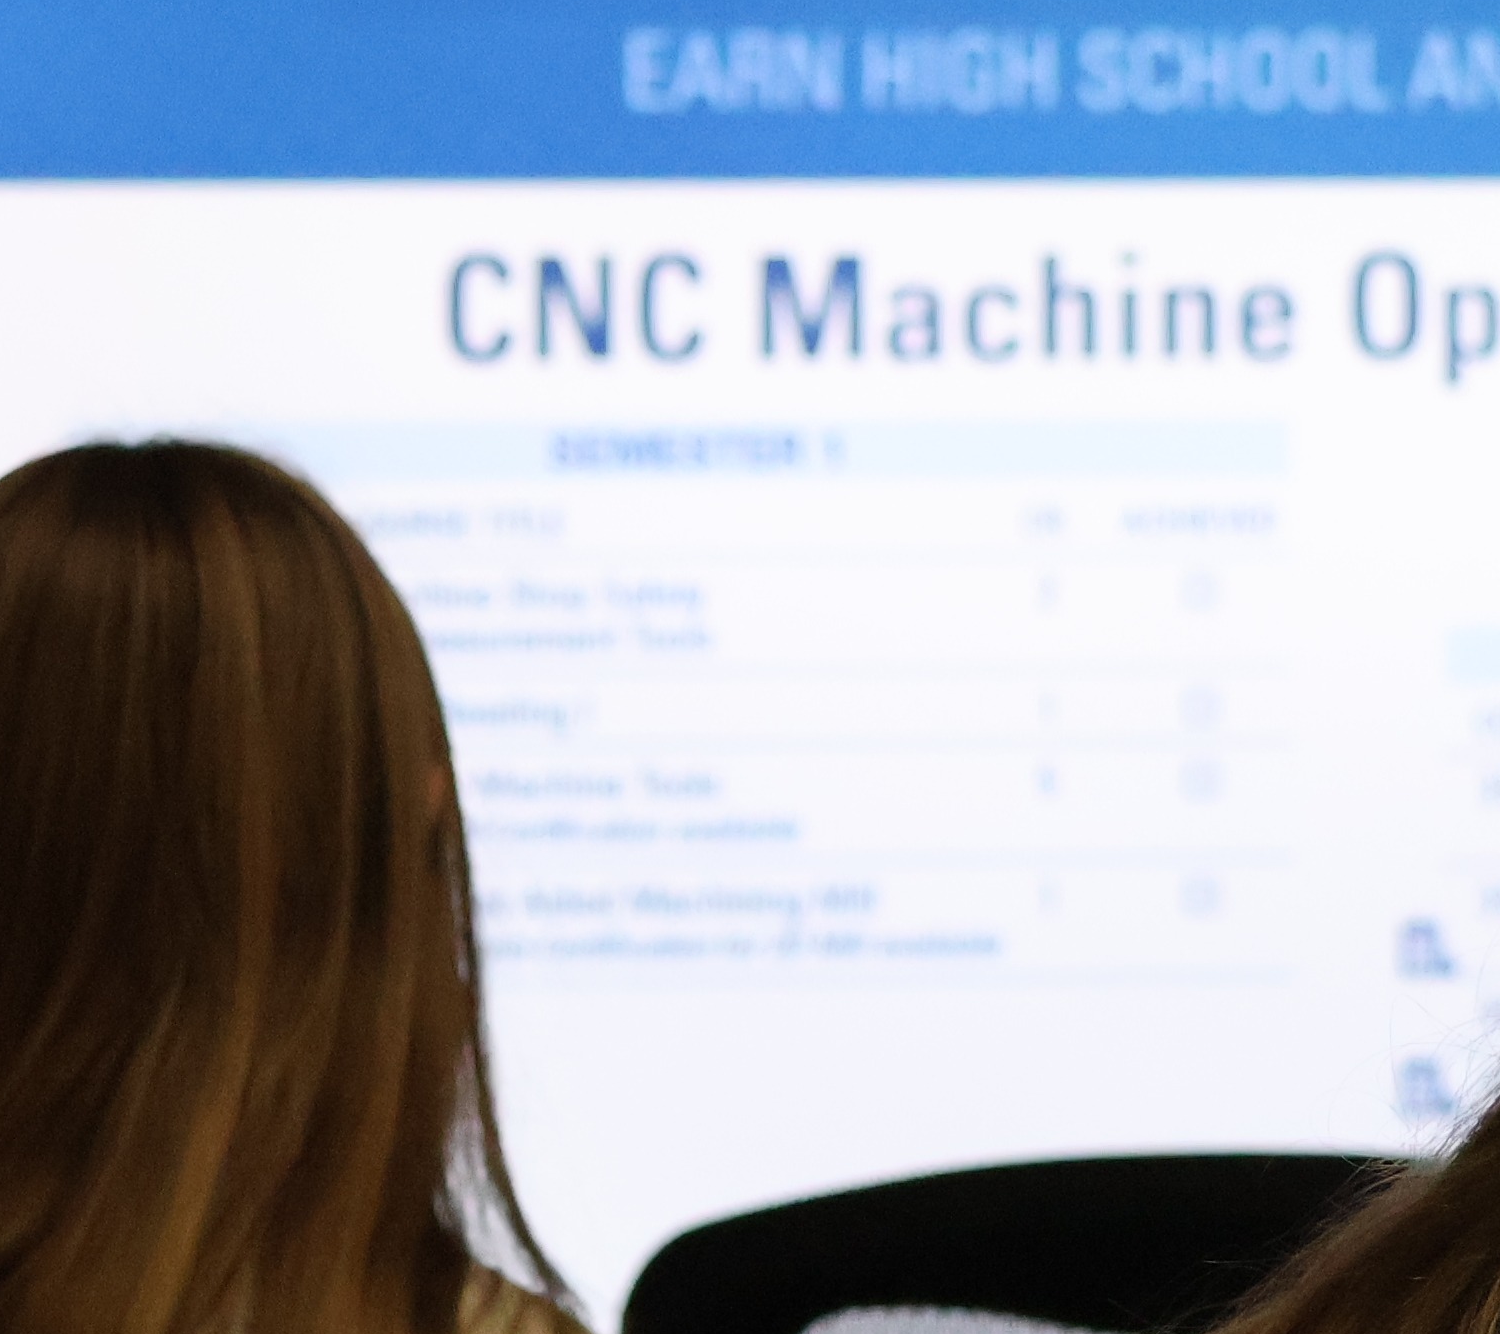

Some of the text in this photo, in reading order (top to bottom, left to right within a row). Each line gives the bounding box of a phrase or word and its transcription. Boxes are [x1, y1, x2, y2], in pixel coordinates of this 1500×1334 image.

[621, 23, 845, 114] EARN
[860, 23, 1060, 114] HIGH
[1076, 22, 1389, 114] SCHOOL
[445, 251, 706, 365] CNC
[756, 251, 1297, 365] Machine
